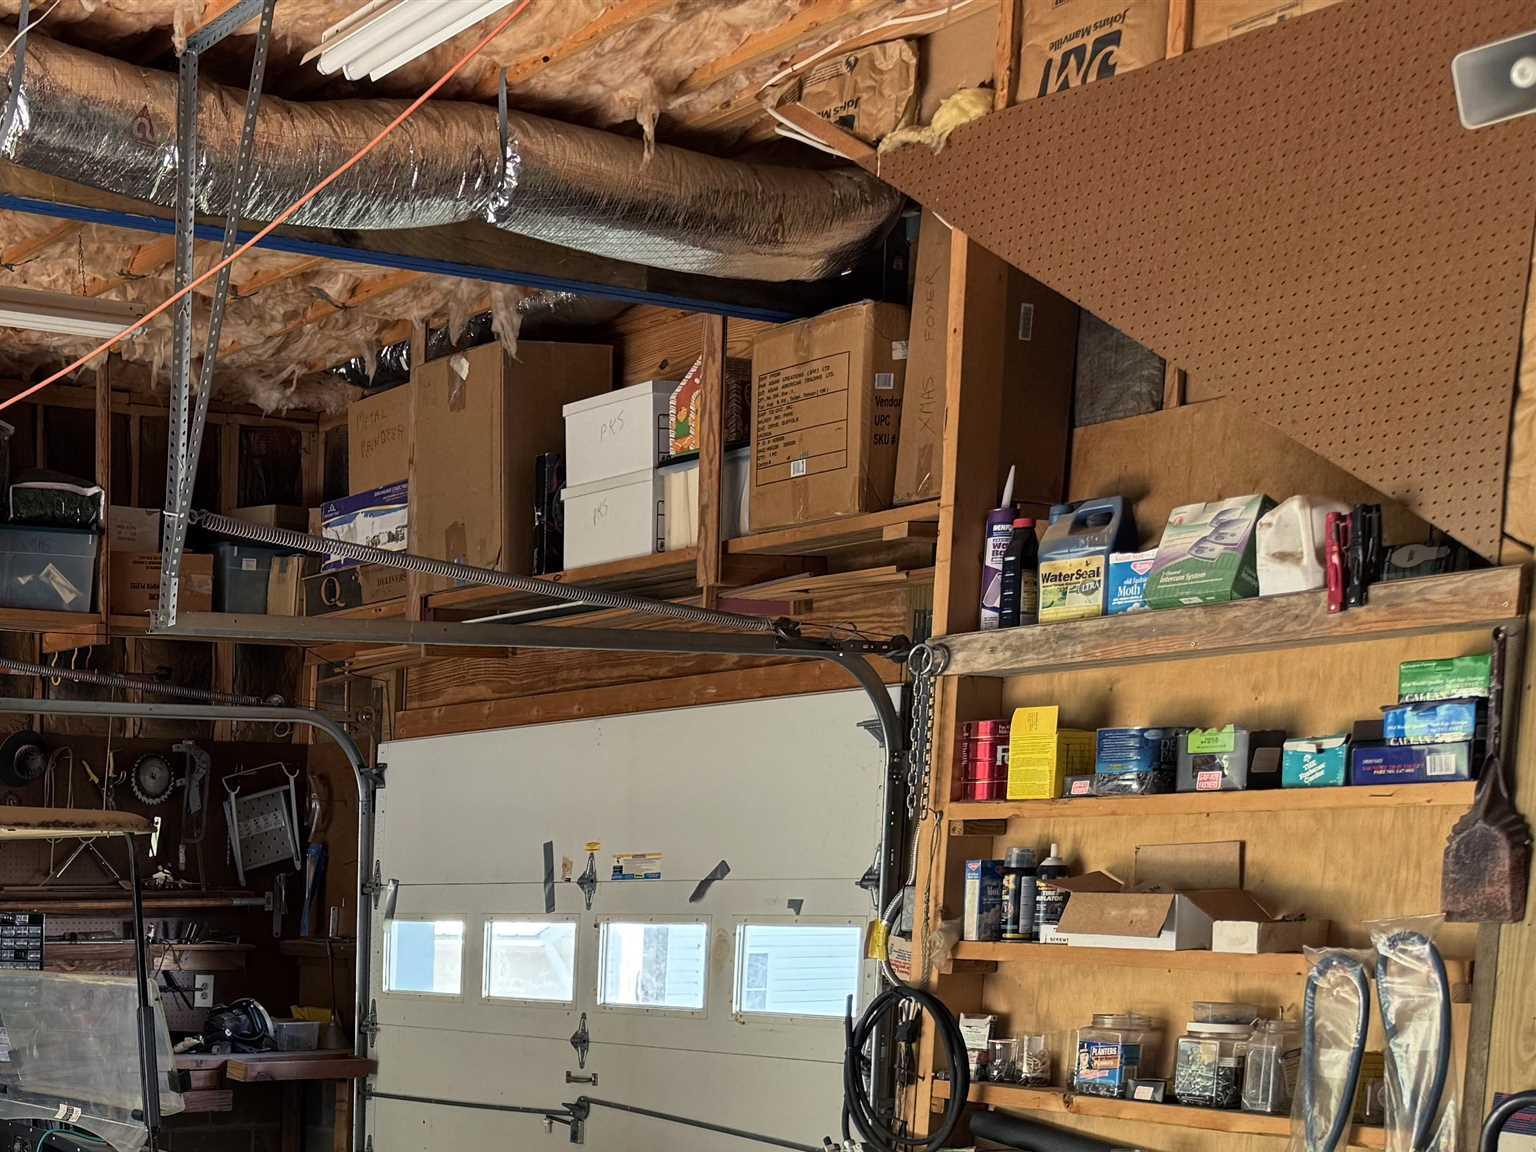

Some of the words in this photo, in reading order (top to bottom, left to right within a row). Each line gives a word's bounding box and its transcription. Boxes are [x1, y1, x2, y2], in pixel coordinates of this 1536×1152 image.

[1093, 8, 1130, 31] Johns
[1049, 26, 1092, 51] Manville
[924, 266, 941, 341] FOYER
[920, 376, 937, 434] XMAS
[874, 415, 890, 426] UPC
[873, 434, 889, 445] SKU
[1041, 566, 1102, 585] WaterSeal
[320, 576, 346, 608] Q
[1117, 582, 1141, 598] Moth
